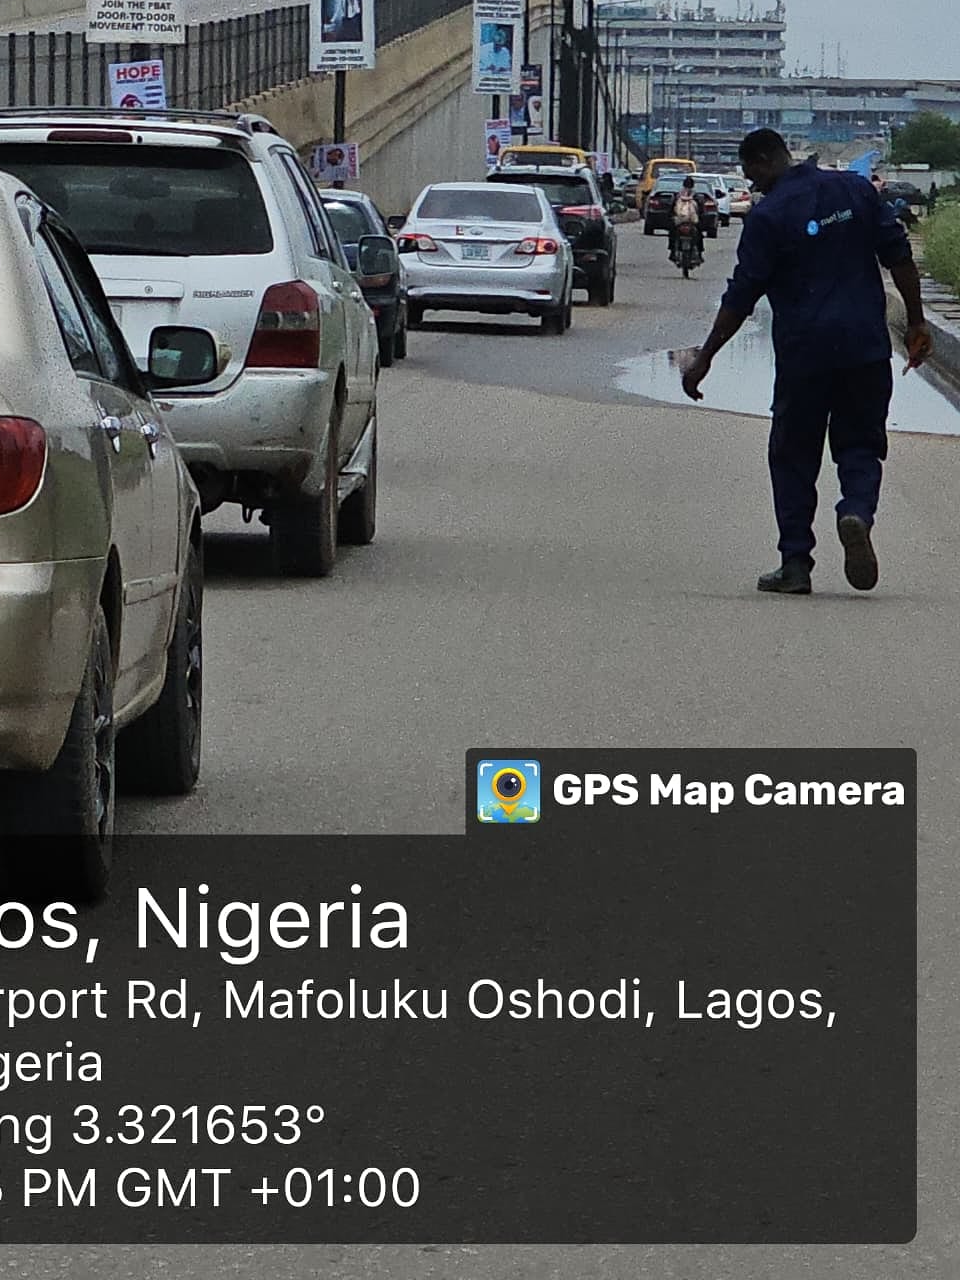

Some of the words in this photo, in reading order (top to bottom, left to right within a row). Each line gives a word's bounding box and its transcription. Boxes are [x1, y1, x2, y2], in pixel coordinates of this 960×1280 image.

[102, 0, 124, 9] JOIN
[127, 1, 145, 10] THE
[97, 11, 175, 22] DOOR-TO-DOOR
[90, 21, 145, 31] MOVEMENT
[116, 65, 161, 79] HOPE
